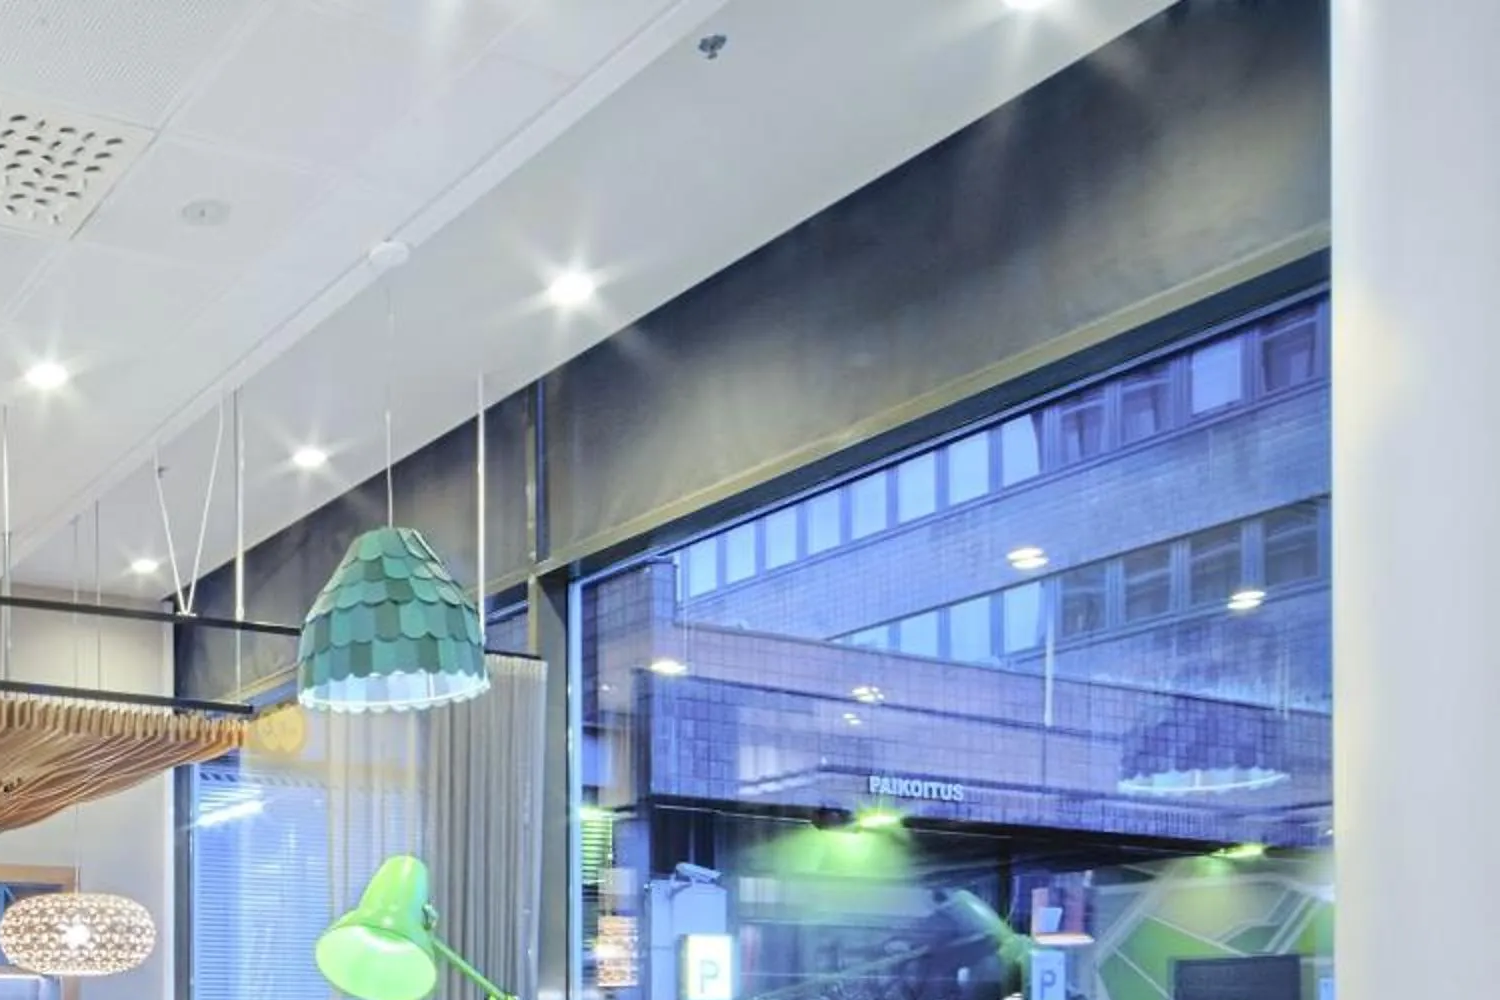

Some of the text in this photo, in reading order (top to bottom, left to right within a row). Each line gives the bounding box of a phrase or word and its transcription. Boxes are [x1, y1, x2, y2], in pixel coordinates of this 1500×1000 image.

[869, 775, 964, 801] PAIKOITUS
[700, 959, 720, 994] P
[1040, 969, 1057, 1000] P
